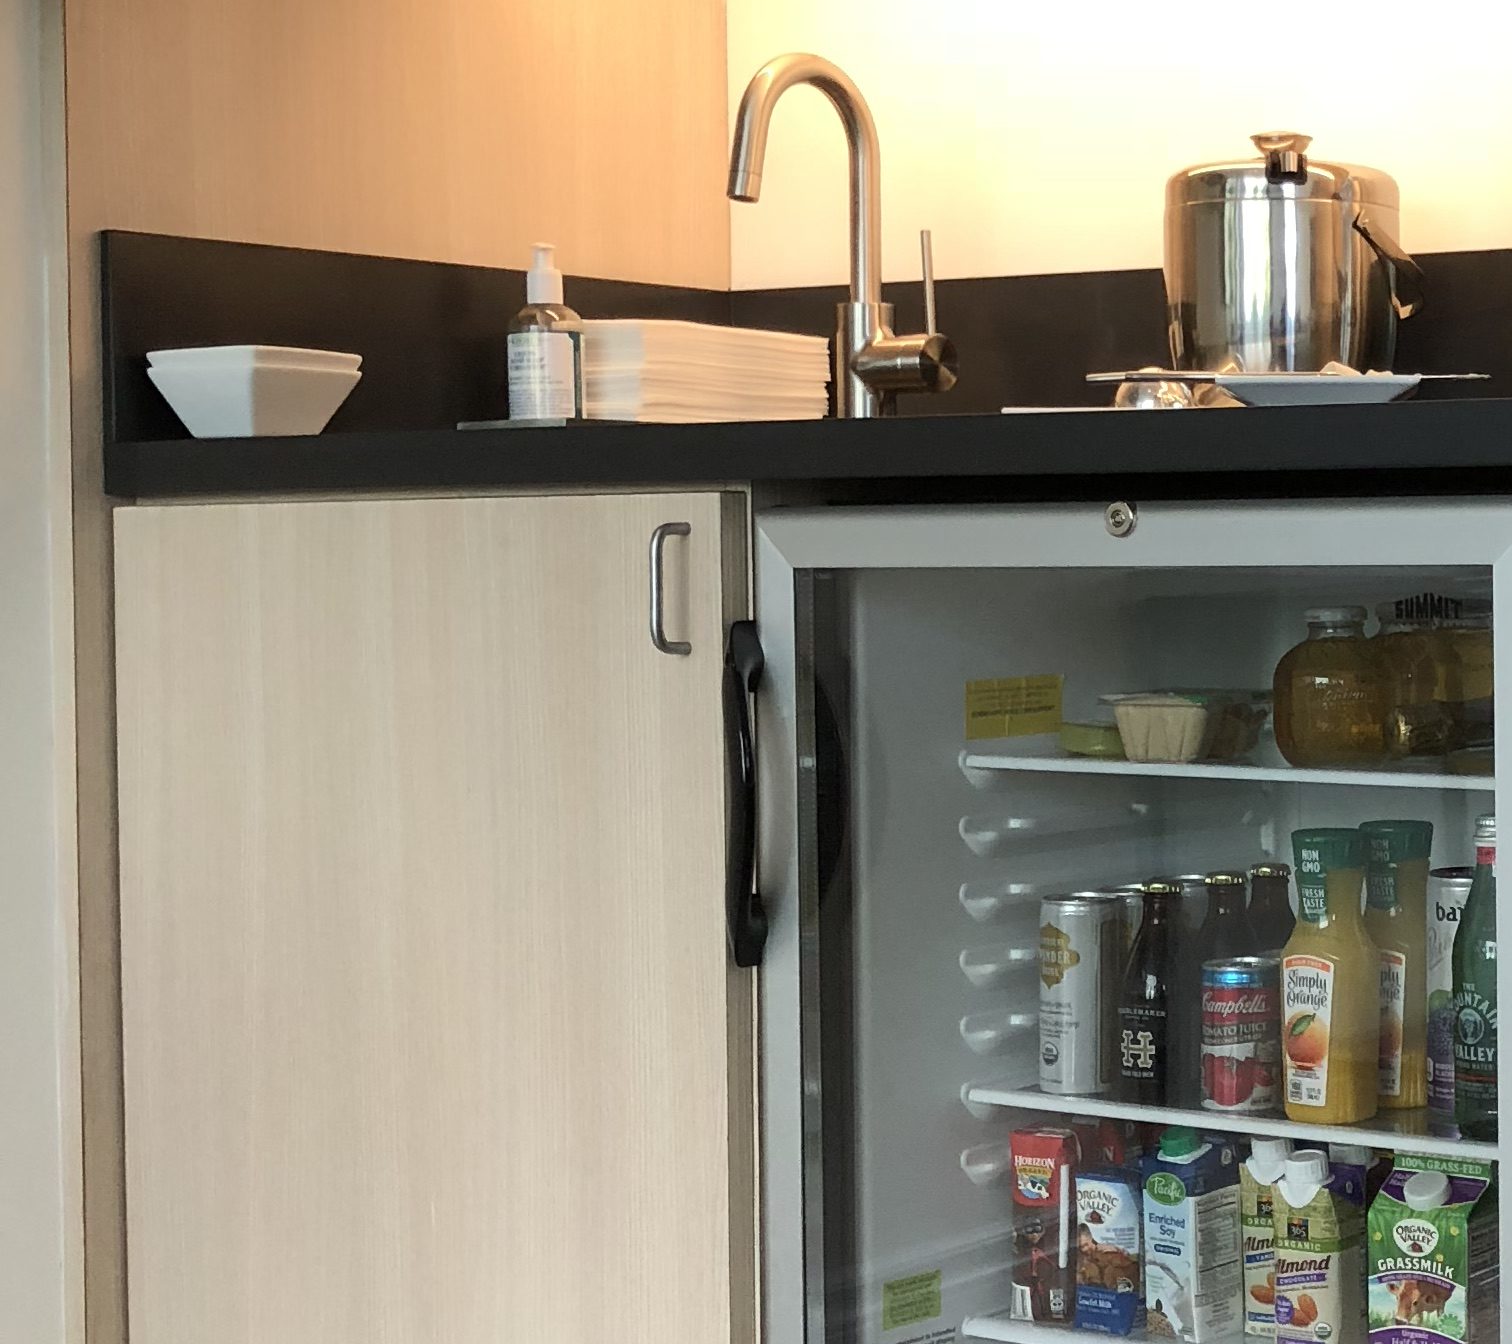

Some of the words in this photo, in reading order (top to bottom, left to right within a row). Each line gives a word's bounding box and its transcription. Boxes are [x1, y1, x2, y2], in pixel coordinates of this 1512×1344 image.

[1301, 848, 1320, 861] NON
[1301, 861, 1321, 873] GMO
[1301, 887, 1325, 898] FRESH
[1302, 897, 1325, 909] TASTE
[1435, 902, 1463, 922] ba
[1287, 969, 1328, 994] Simply
[1286, 988, 1328, 1010] Orange
[1014, 1154, 1056, 1170] HORIZON
[1426, 1159, 1483, 1175] GRASS-FED
[1151, 1176, 1183, 1202] Pacific
[1076, 1189, 1120, 1208] ORGANIC
[1079, 1199, 1113, 1217] VALLEY
[1149, 1212, 1186, 1229] Enriched
[1159, 1224, 1177, 1240] Soy
[1395, 1224, 1437, 1240] ORGANIC
[1399, 1234, 1432, 1247] VALLEY
[1377, 1256, 1455, 1280] GRASSMILK
